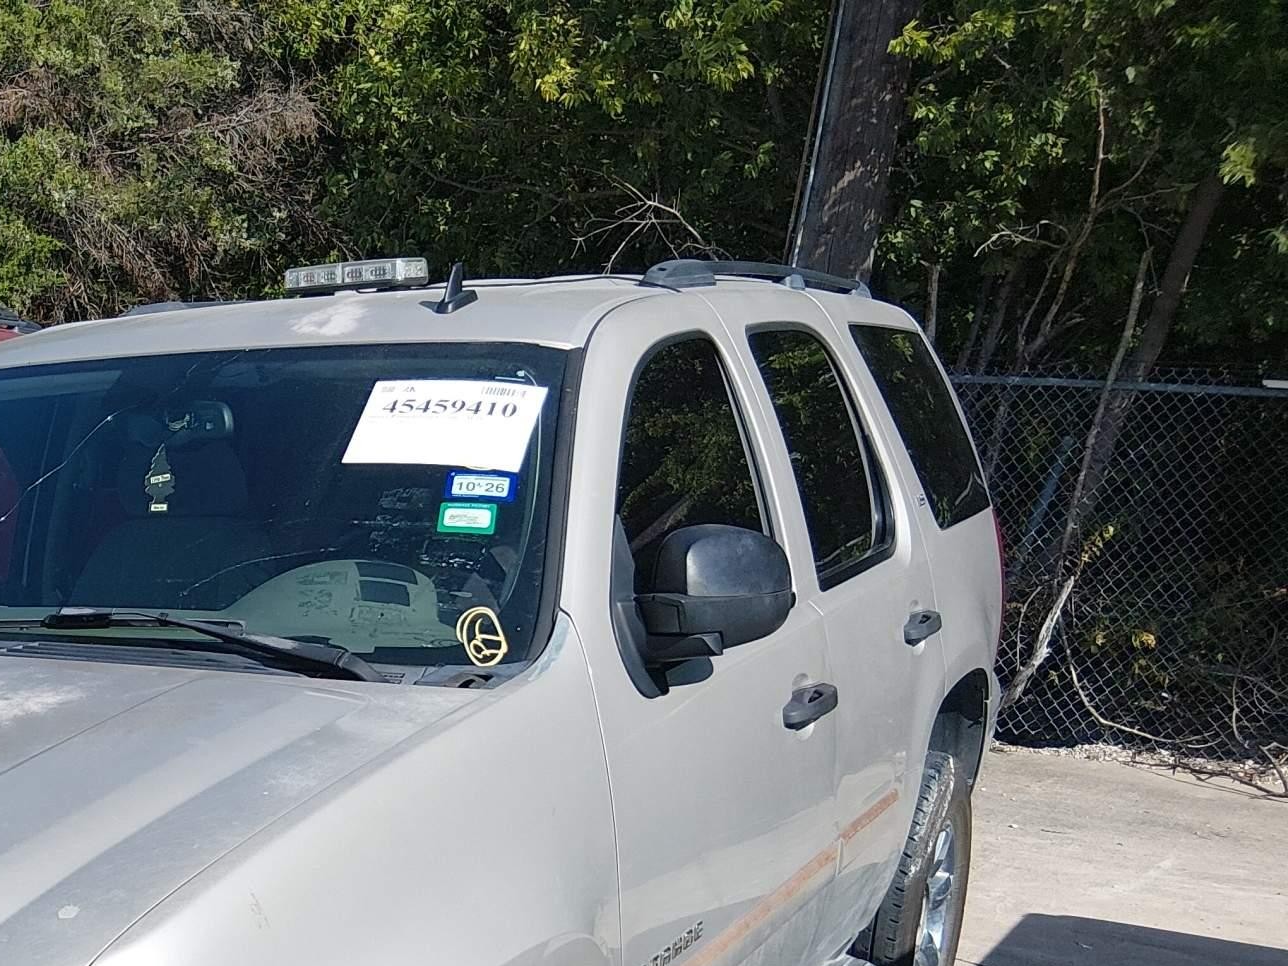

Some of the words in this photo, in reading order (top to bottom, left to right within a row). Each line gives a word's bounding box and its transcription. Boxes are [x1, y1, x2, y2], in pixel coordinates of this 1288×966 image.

[382, 399, 518, 418] 45459410
[456, 481, 476, 492] 10
[484, 482, 505, 493] 26
